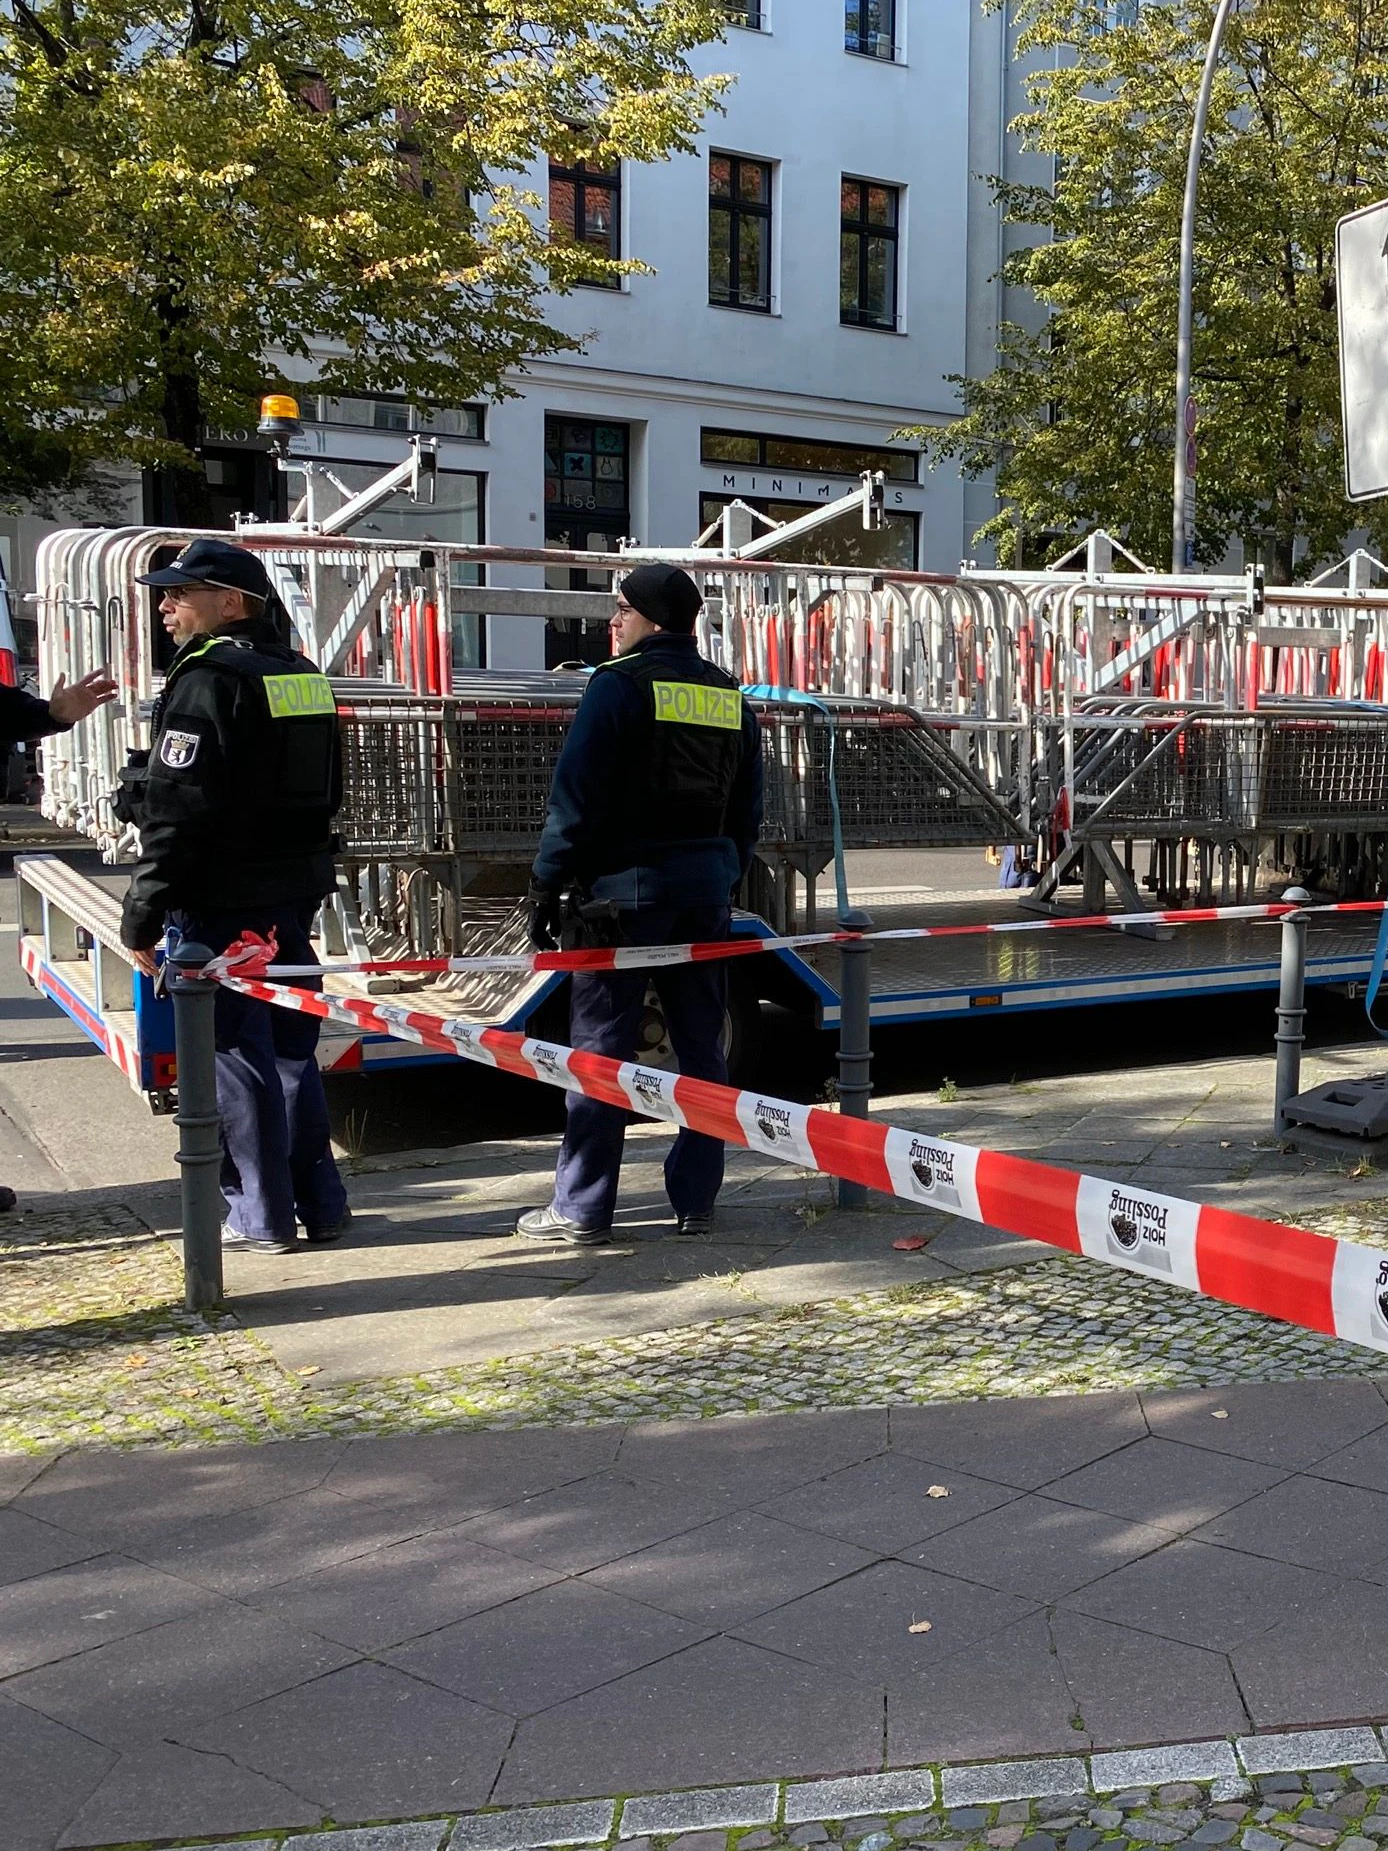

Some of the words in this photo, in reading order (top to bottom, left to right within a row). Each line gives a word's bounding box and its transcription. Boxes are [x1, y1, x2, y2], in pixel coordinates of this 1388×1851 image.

[723, 474, 903, 504] MINIMAS
[268, 677, 334, 712] POLIZE
[656, 685, 740, 725] POLIZEI
[632, 1068, 663, 1093] Possling
[754, 1100, 791, 1128] Possling
[908, 1138, 955, 1172] Possling
[1108, 1188, 1169, 1230] Possling
